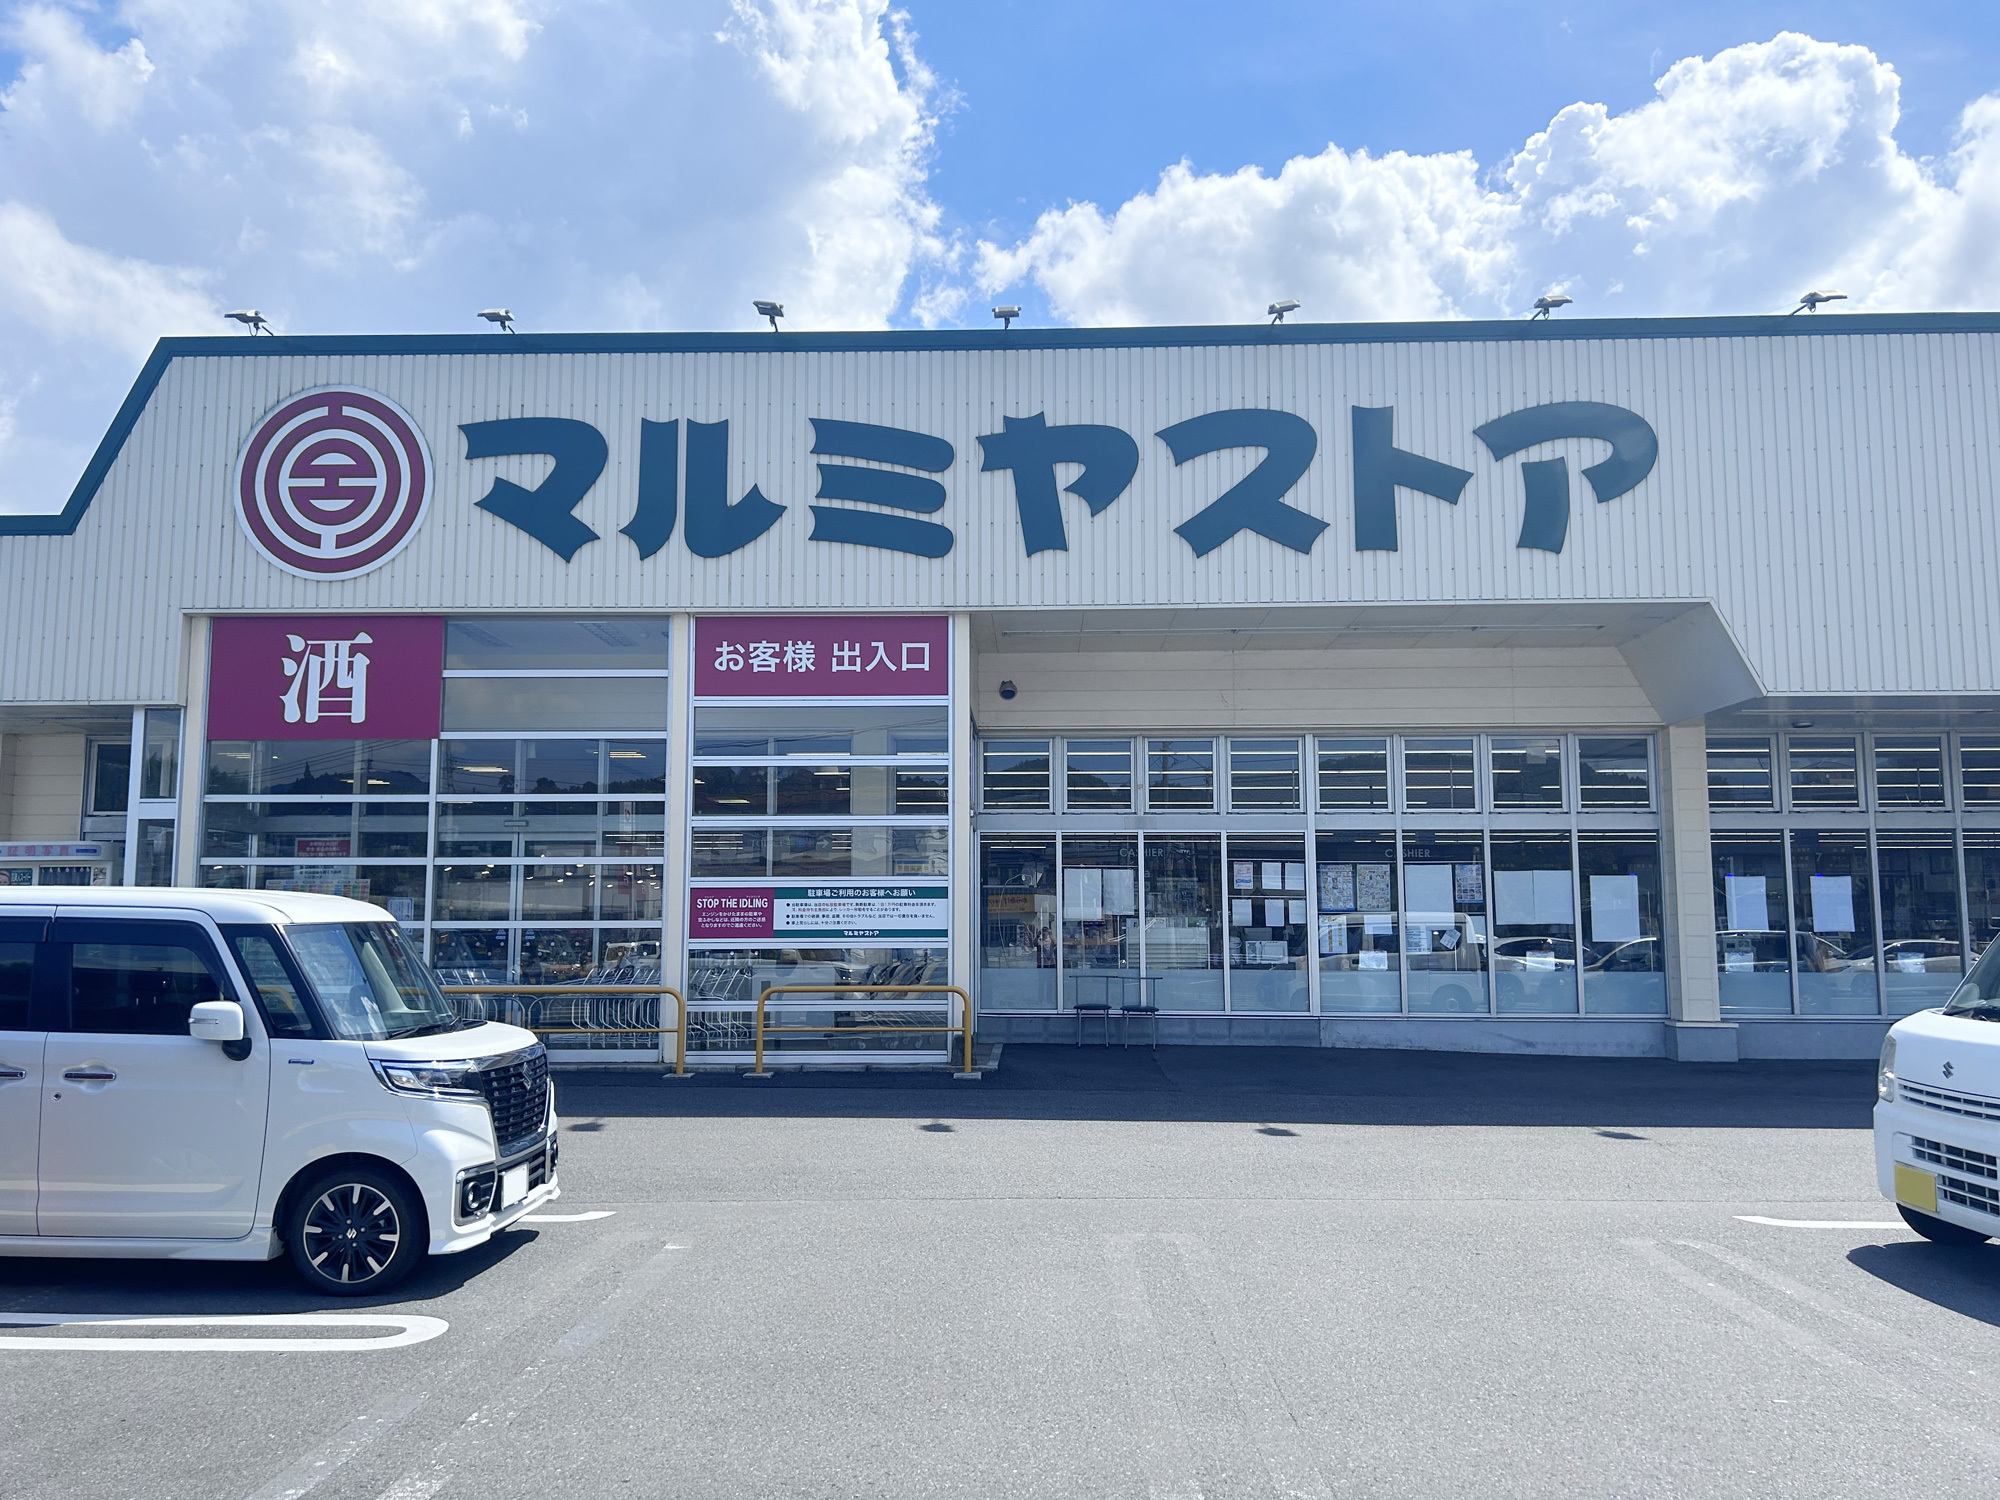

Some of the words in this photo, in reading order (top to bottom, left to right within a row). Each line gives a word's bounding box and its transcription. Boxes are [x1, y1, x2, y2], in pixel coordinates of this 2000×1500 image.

[458, 400, 1659, 564] マルミヤストア
[712, 640, 816, 674] お客様
[831, 640, 932, 673] 出入口
[280, 631, 374, 725] 酒
[7, 845, 70, 857] 証明写真
[1119, 848, 1164, 857] CAHIER
[1384, 848, 1431, 858] CSHIER
[807, 889, 916, 897] 駐車場ご利用のお客様へお願い
[696, 898, 720, 909] STOP
[721, 898, 738, 908] THE
[739, 898, 769, 908] IDLING
